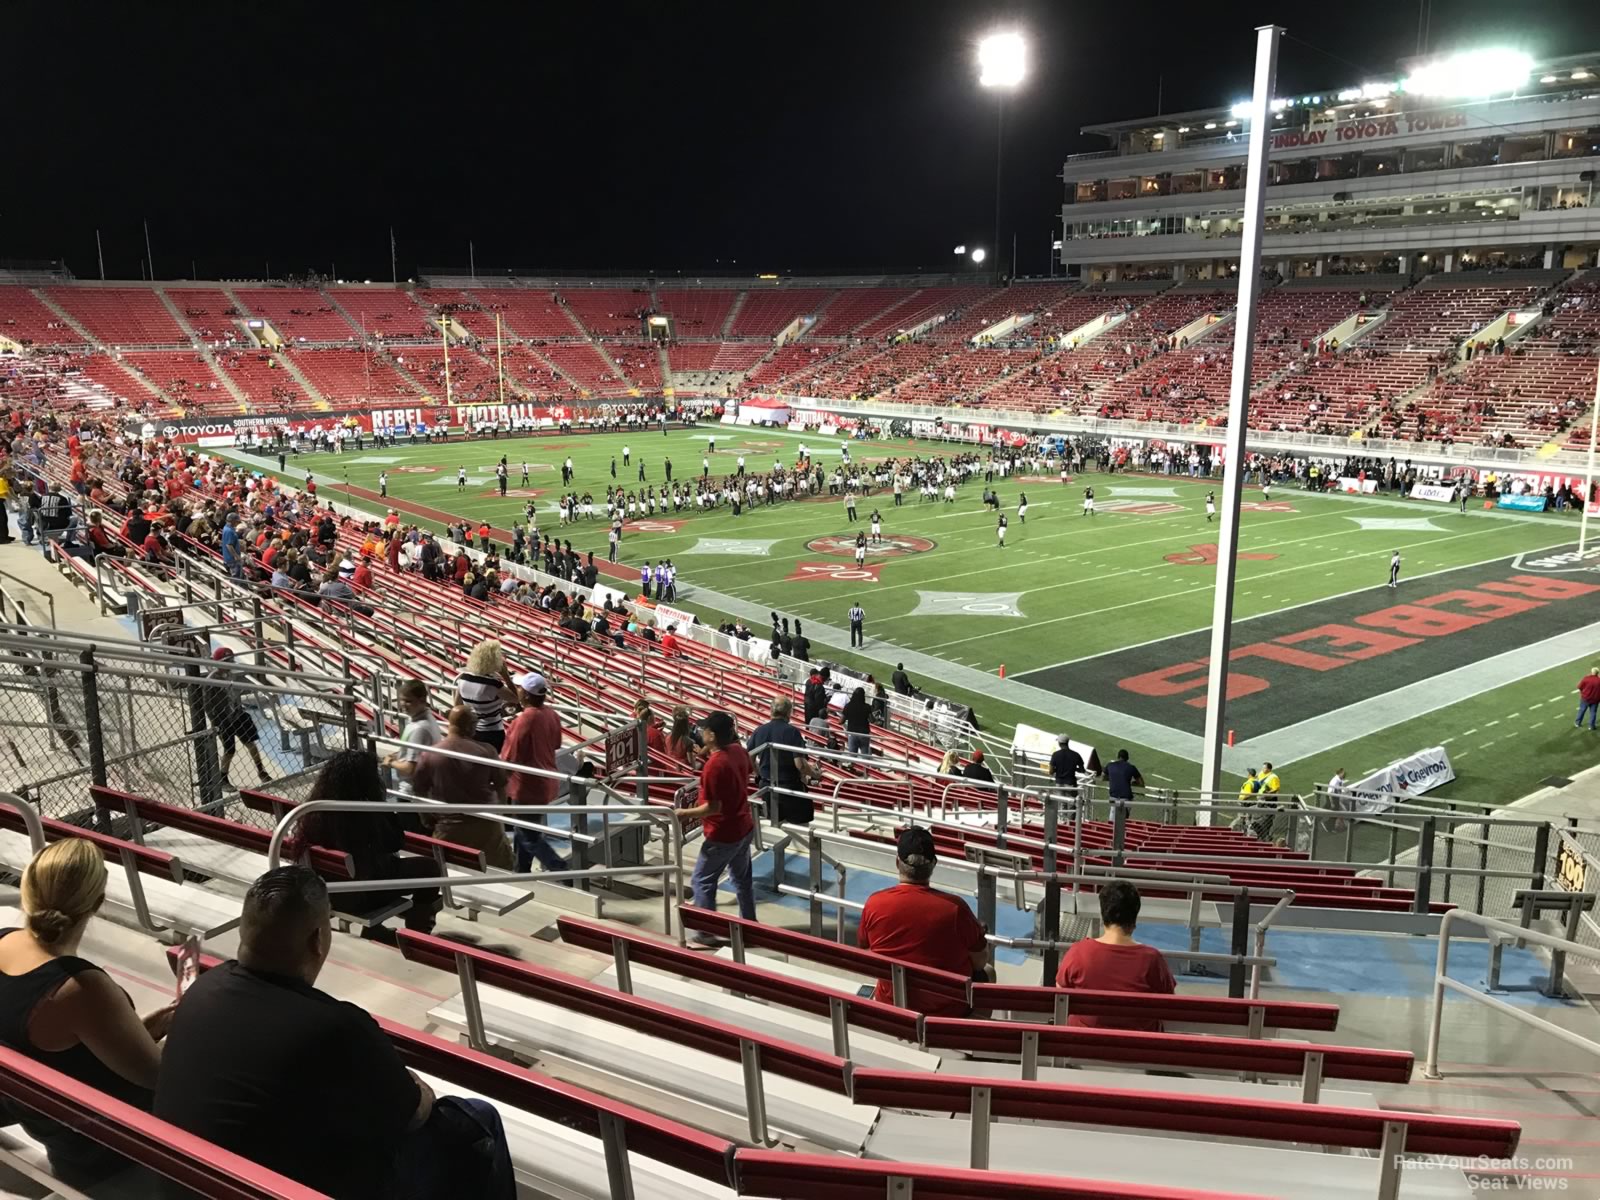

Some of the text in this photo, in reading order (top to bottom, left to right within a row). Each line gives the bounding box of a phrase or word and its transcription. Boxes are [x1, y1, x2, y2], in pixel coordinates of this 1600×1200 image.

[1335, 119, 1399, 142] TOYOTA
[1405, 112, 1468, 133] TOWER
[180, 424, 233, 436] TOYOTA
[233, 416, 288, 427] SOUTHERN NEVADA
[371, 408, 422, 430] REBEL
[1116, 575, 1600, 708] REBELS
[610, 737, 634, 762] 101
[1407, 760, 1447, 783] Chevron
[1559, 851, 1584, 890] 100
